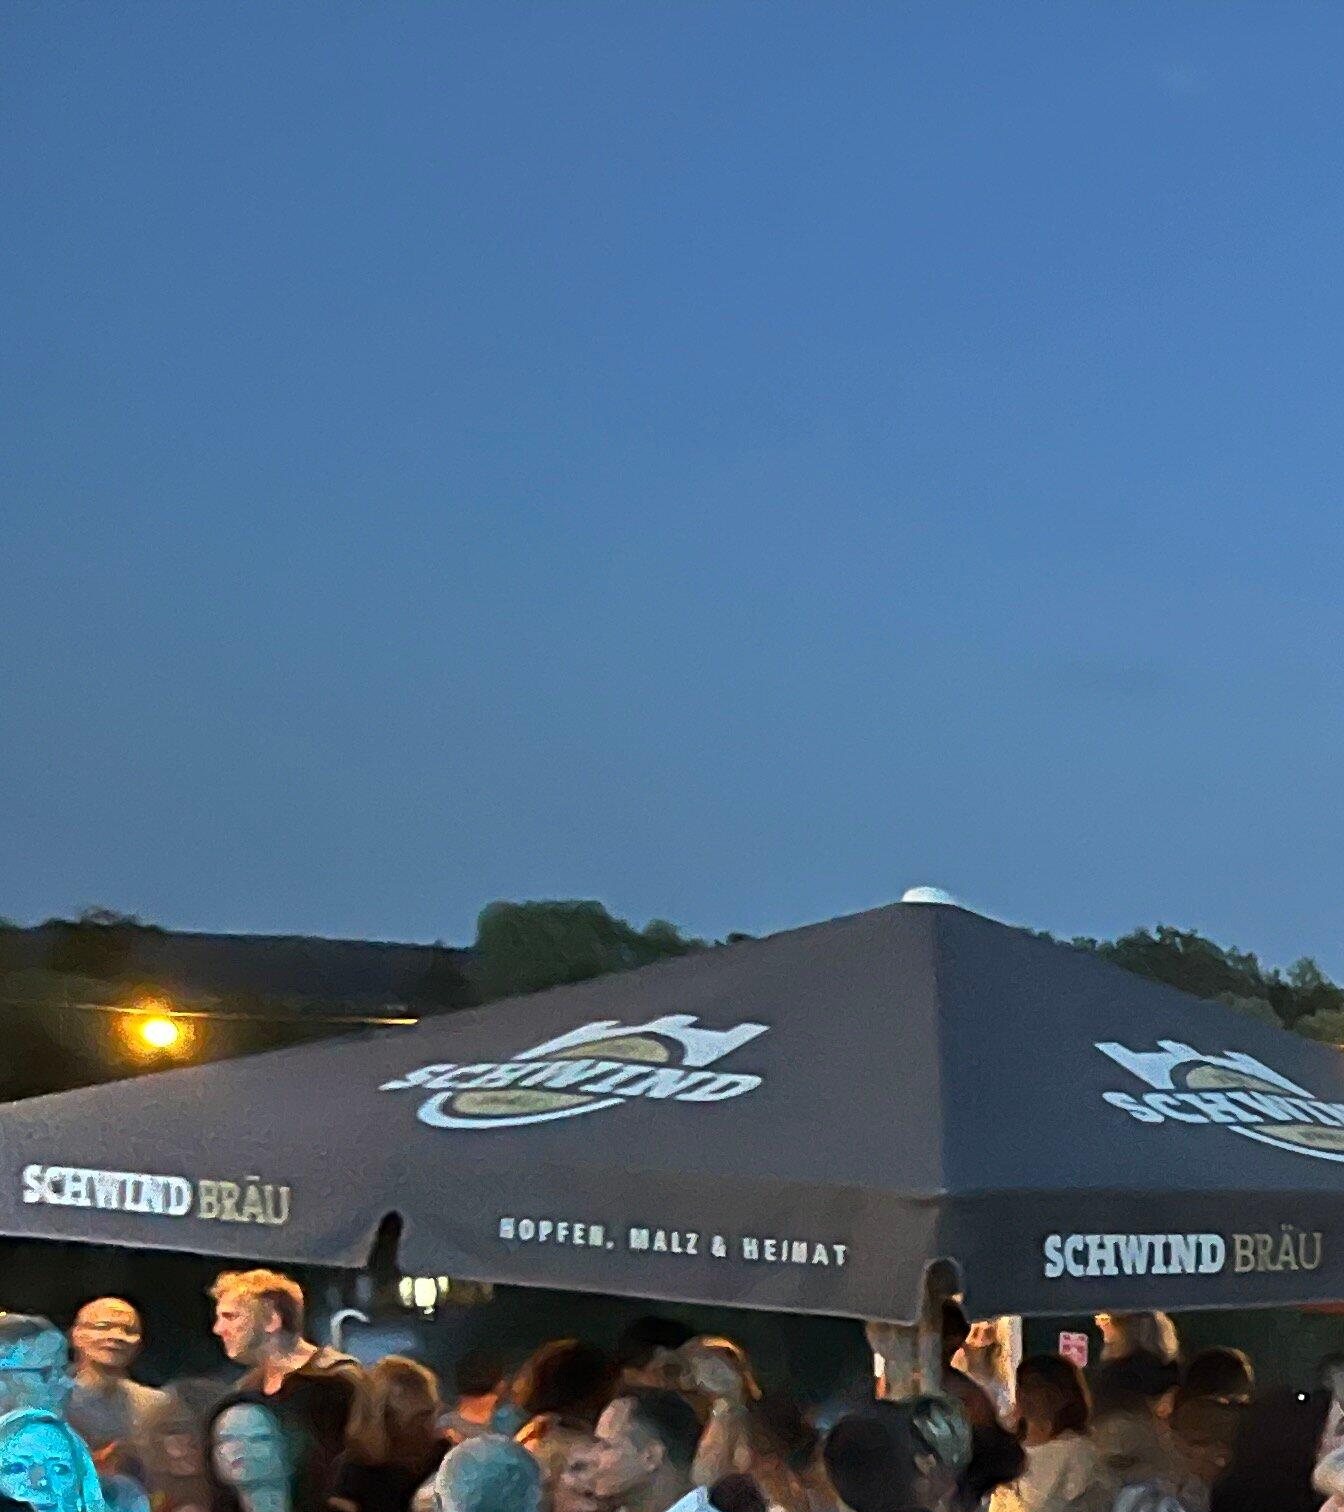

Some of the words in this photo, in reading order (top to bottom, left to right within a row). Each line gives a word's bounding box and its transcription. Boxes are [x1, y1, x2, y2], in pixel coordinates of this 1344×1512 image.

[379, 1059, 762, 1101] SCHWIND
[22, 1164, 193, 1216] SCHWIND
[198, 1175, 291, 1225] BRÄU
[629, 1228, 699, 1254] MALZ
[711, 1235, 728, 1257] &
[743, 1237, 848, 1266] HEIMAT
[1044, 1233, 1226, 1278] SCHWIND
[1232, 1223, 1323, 1273] BRÄU
